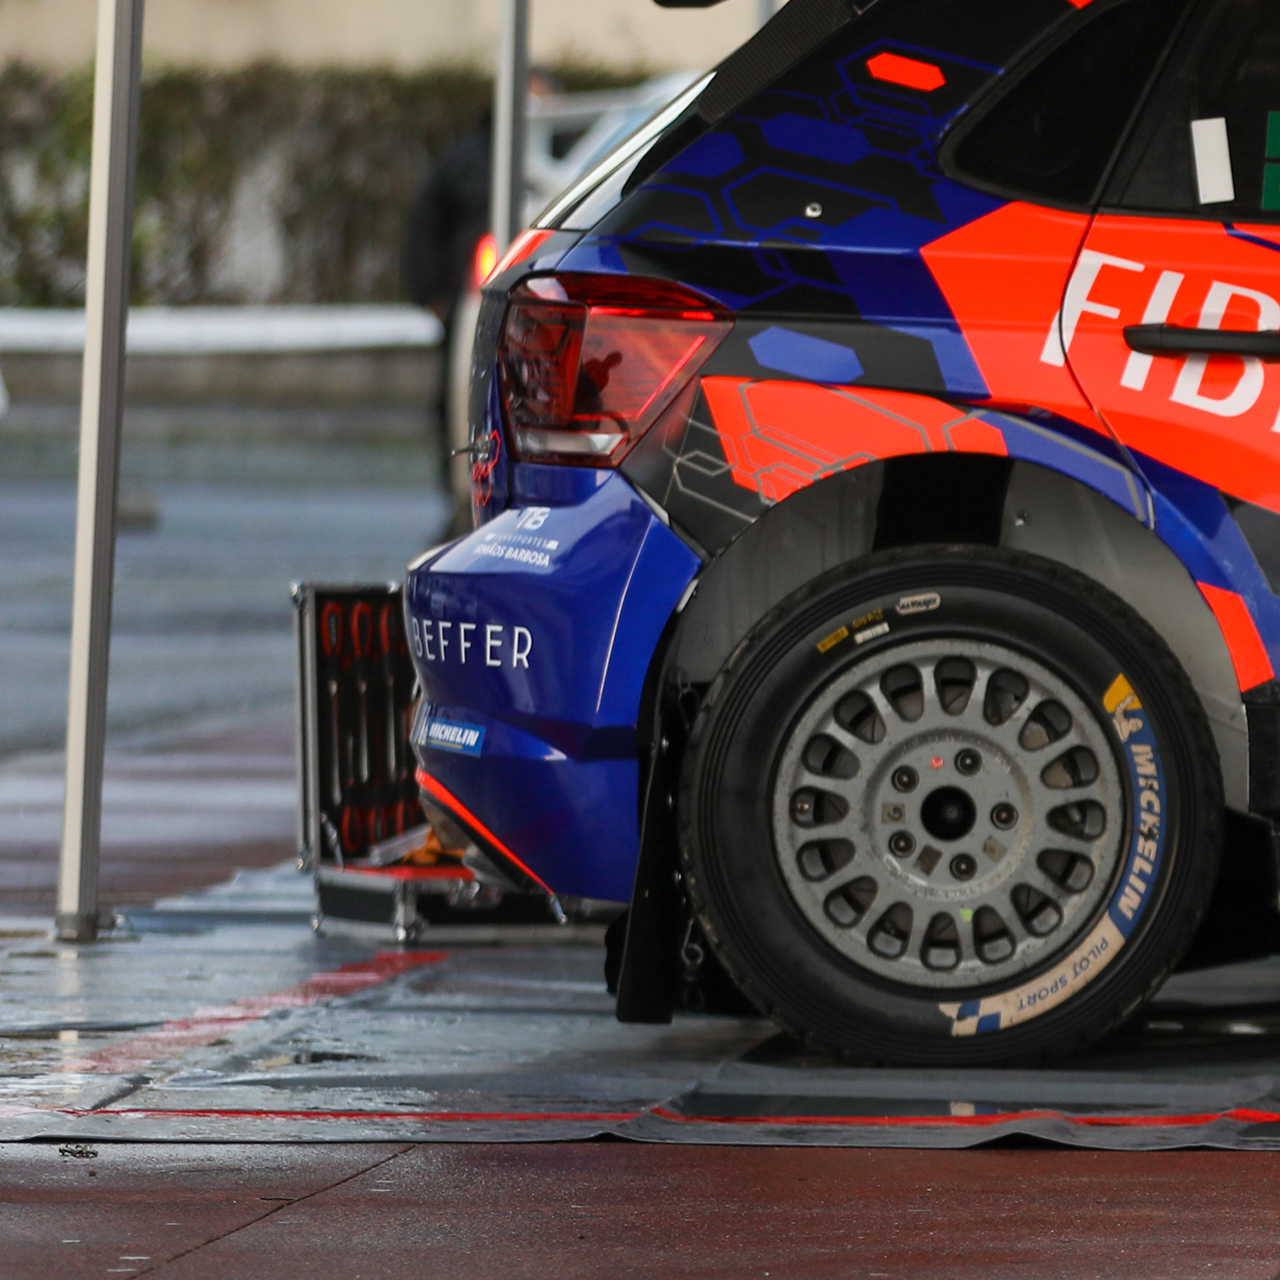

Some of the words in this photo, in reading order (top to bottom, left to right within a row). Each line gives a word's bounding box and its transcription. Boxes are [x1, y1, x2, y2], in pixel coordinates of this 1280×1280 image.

[504, 546, 551, 568] BARBOSA
[428, 722, 480, 748] MICHELIN
[1117, 743, 1162, 921] MICHELIN
[1073, 936, 1109, 980] PILOT
[1017, 974, 1068, 1012] SPORT
